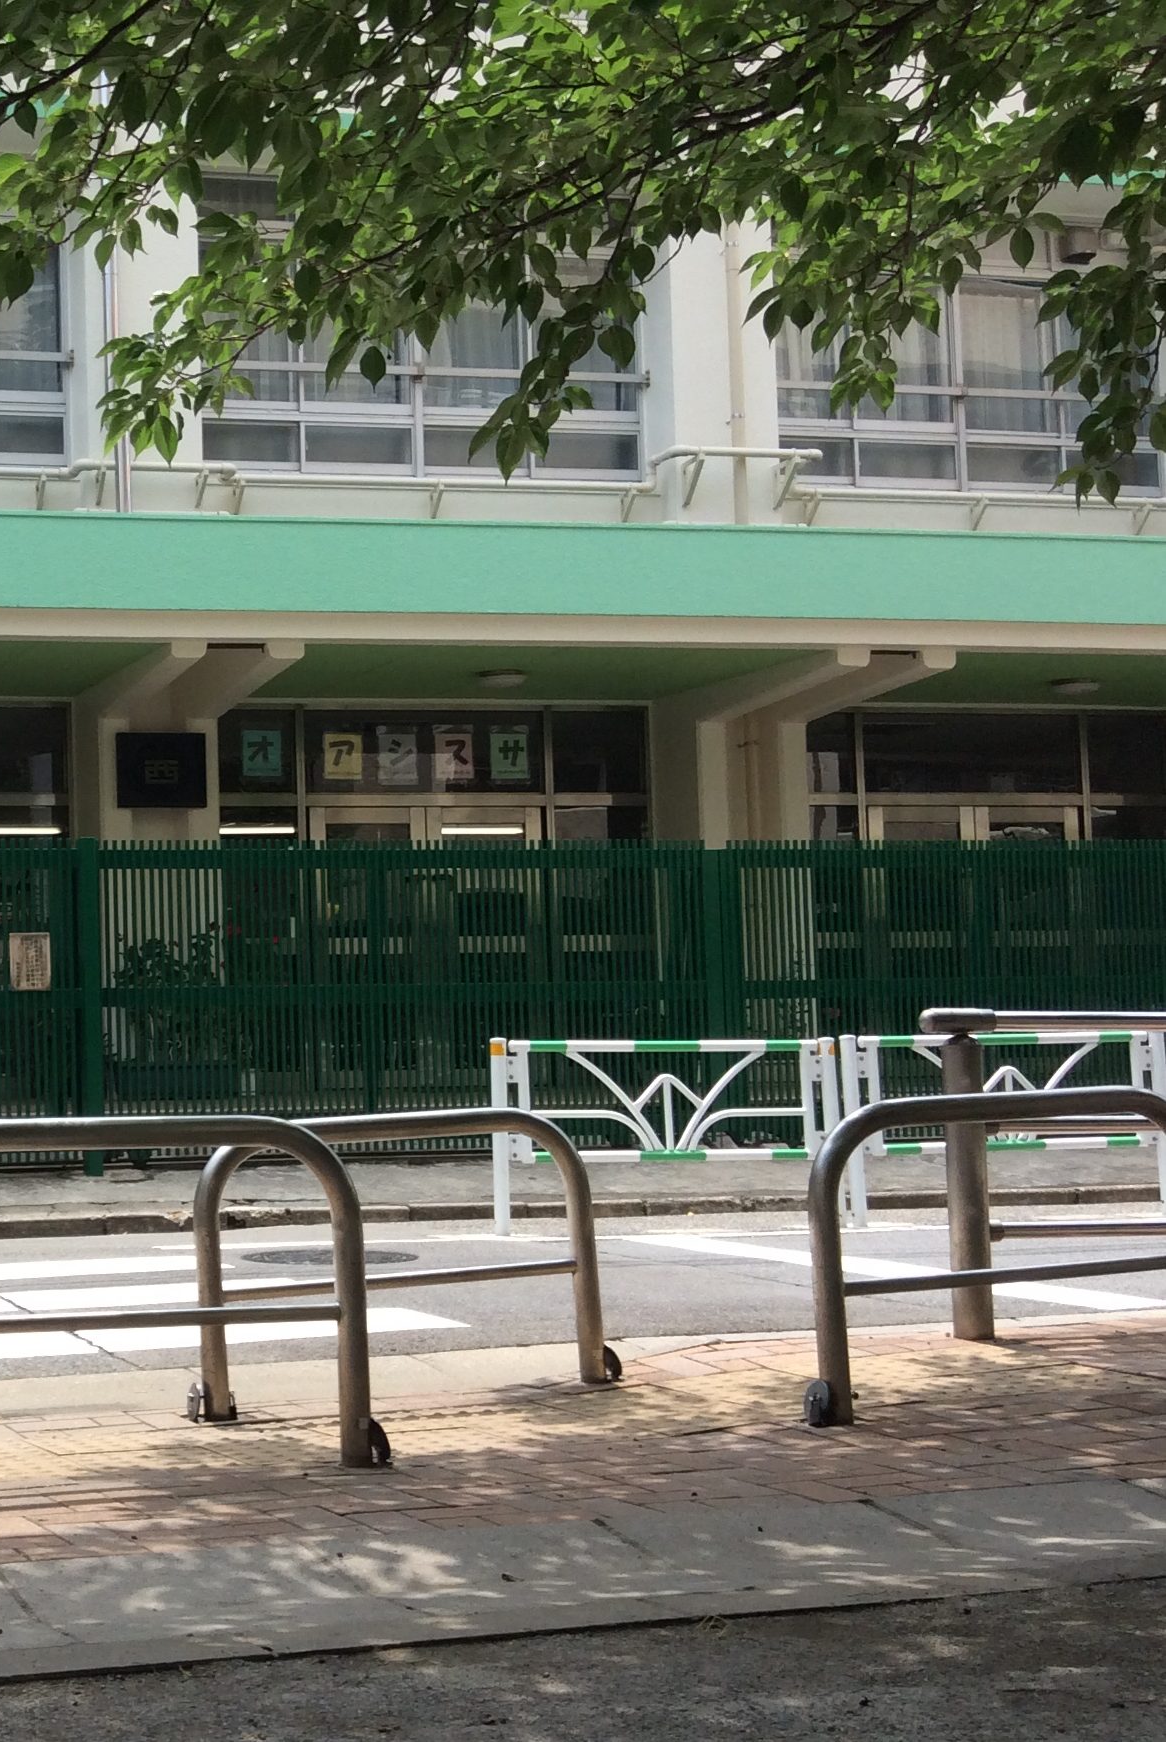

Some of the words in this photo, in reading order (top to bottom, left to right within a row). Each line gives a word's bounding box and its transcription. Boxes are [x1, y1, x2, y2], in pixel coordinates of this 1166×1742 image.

[246, 735, 275, 764] オ
[328, 740, 356, 767] ア
[387, 738, 414, 767] シ
[444, 739, 470, 765] ス
[498, 739, 525, 767] サ
